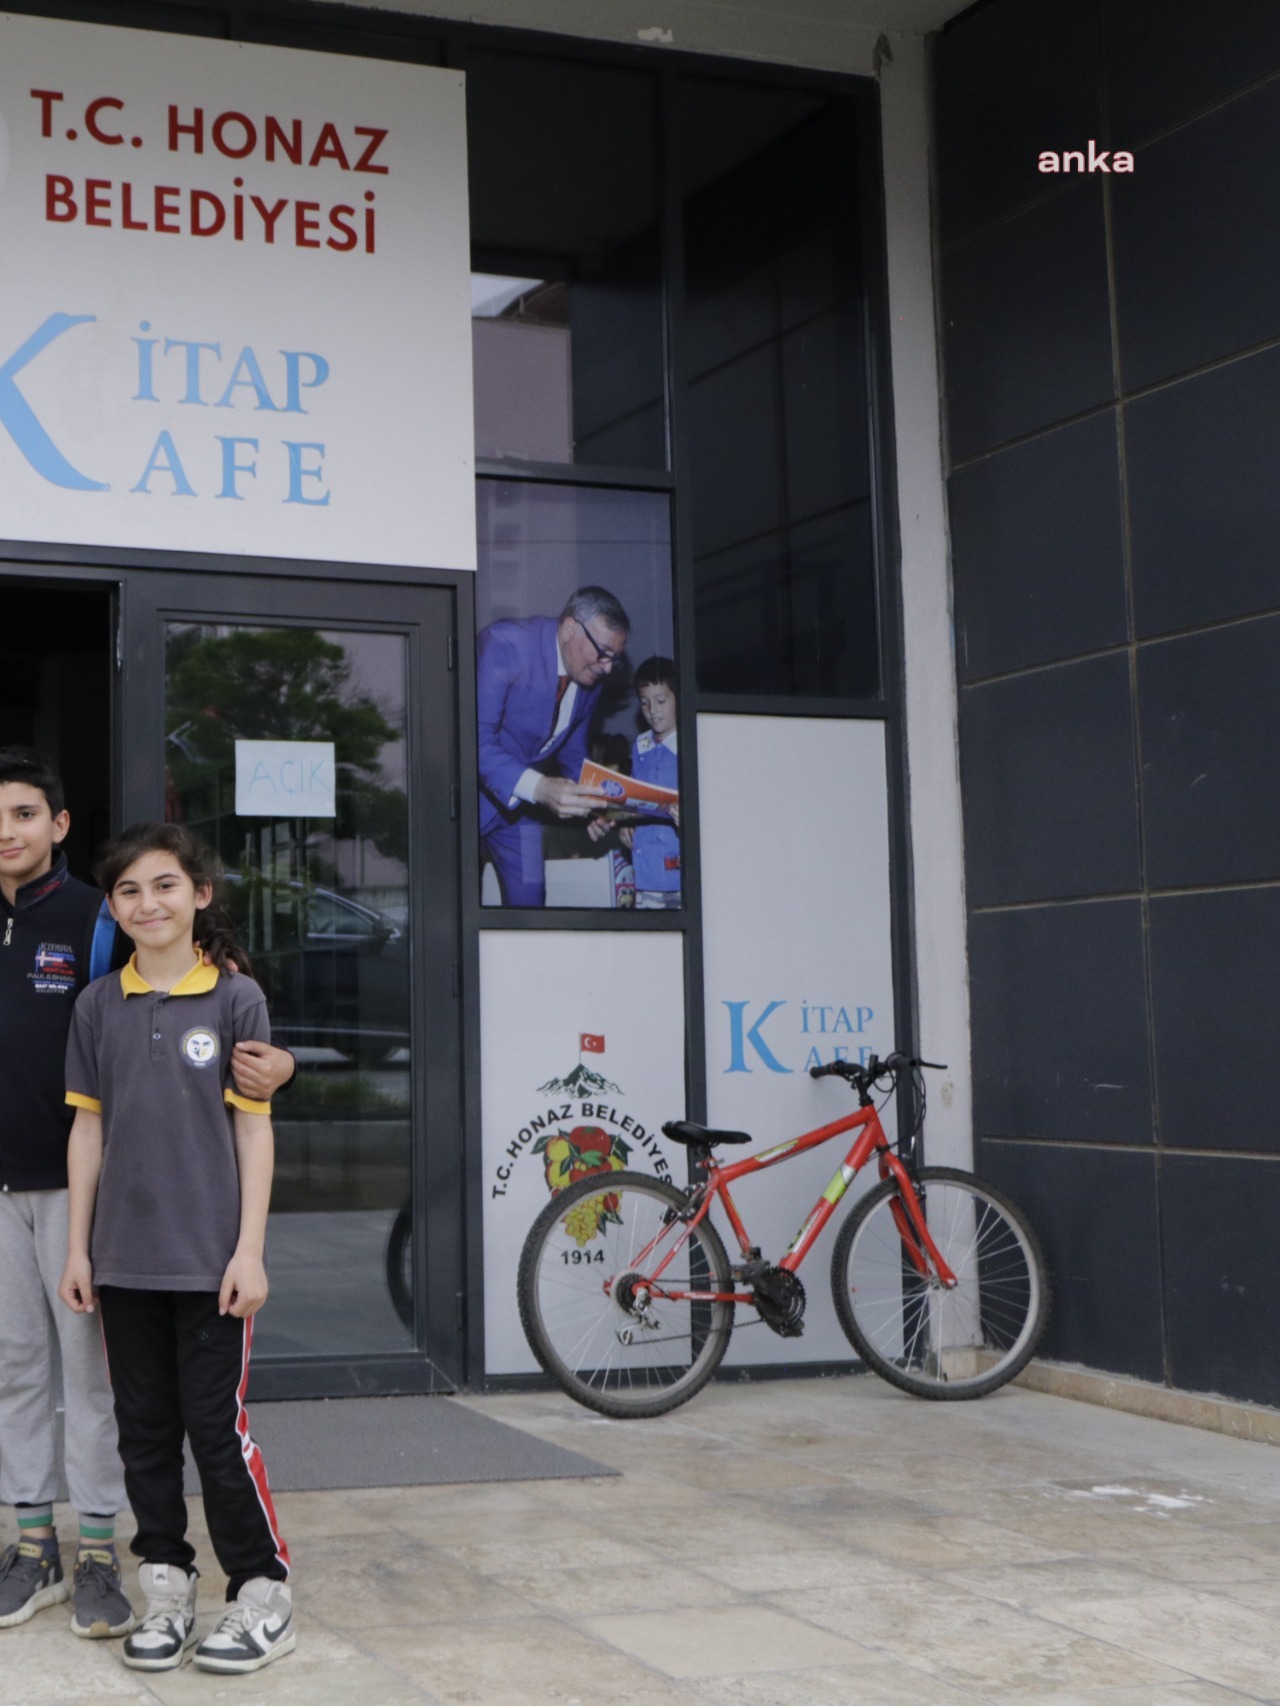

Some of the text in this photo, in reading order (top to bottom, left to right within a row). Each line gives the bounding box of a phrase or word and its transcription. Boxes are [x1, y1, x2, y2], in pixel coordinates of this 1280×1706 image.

[29, 88, 389, 176] T.C. HONAZ
[44, 173, 376, 255] BELEDİYESİ
[492, 1161, 514, 1200] T.C.
[505, 1103, 574, 1160] HONAZ
[560, 1249, 605, 1265] 1914
